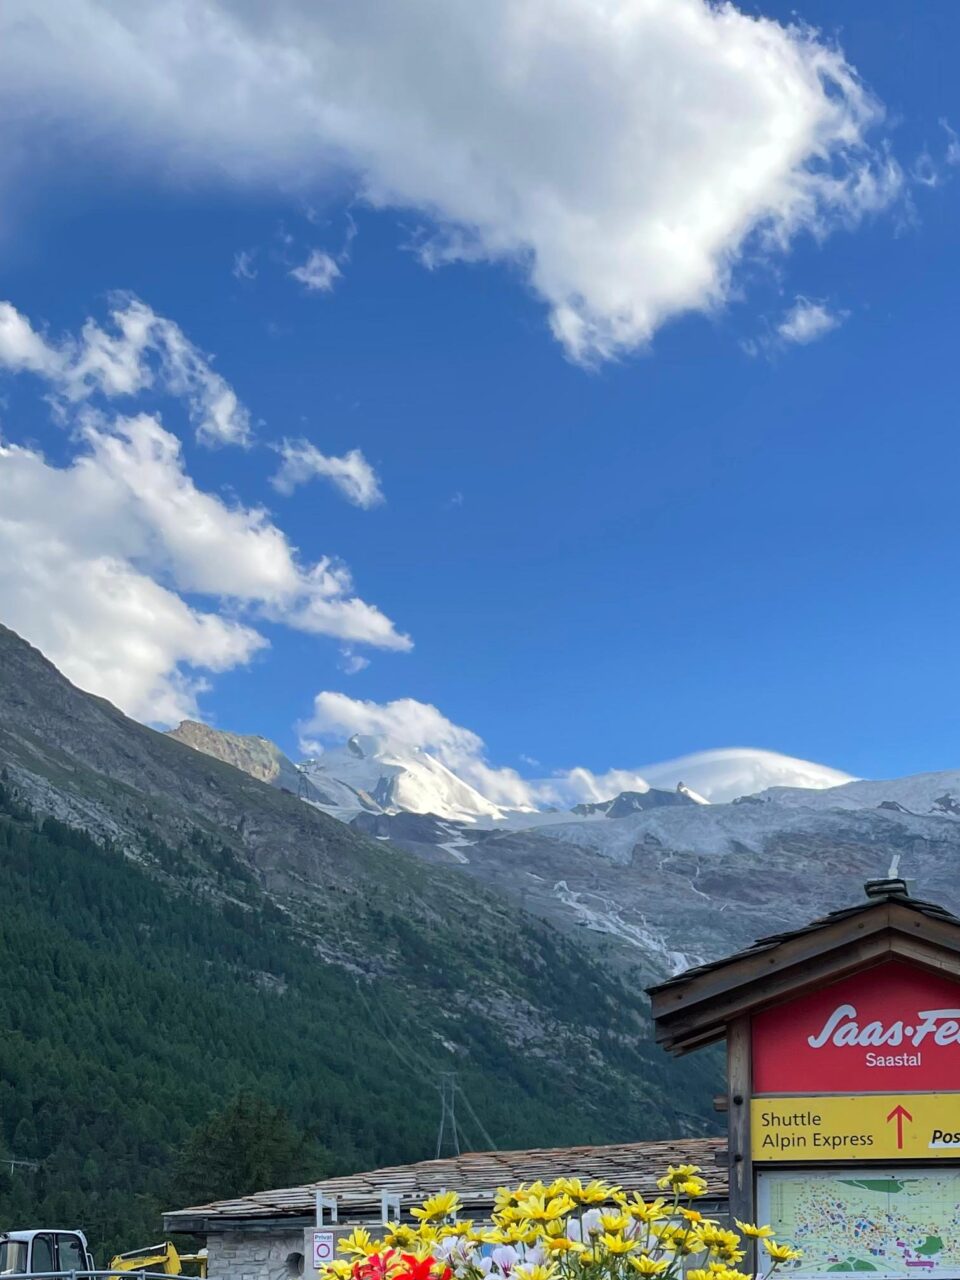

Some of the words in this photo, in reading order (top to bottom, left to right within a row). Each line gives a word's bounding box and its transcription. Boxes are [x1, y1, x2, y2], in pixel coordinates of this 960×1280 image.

[865, 1052, 921, 1067] Saastal
[761, 1111, 822, 1127] Shuttle
[762, 1133, 807, 1151] Alpin
[812, 1133, 874, 1150] Express
